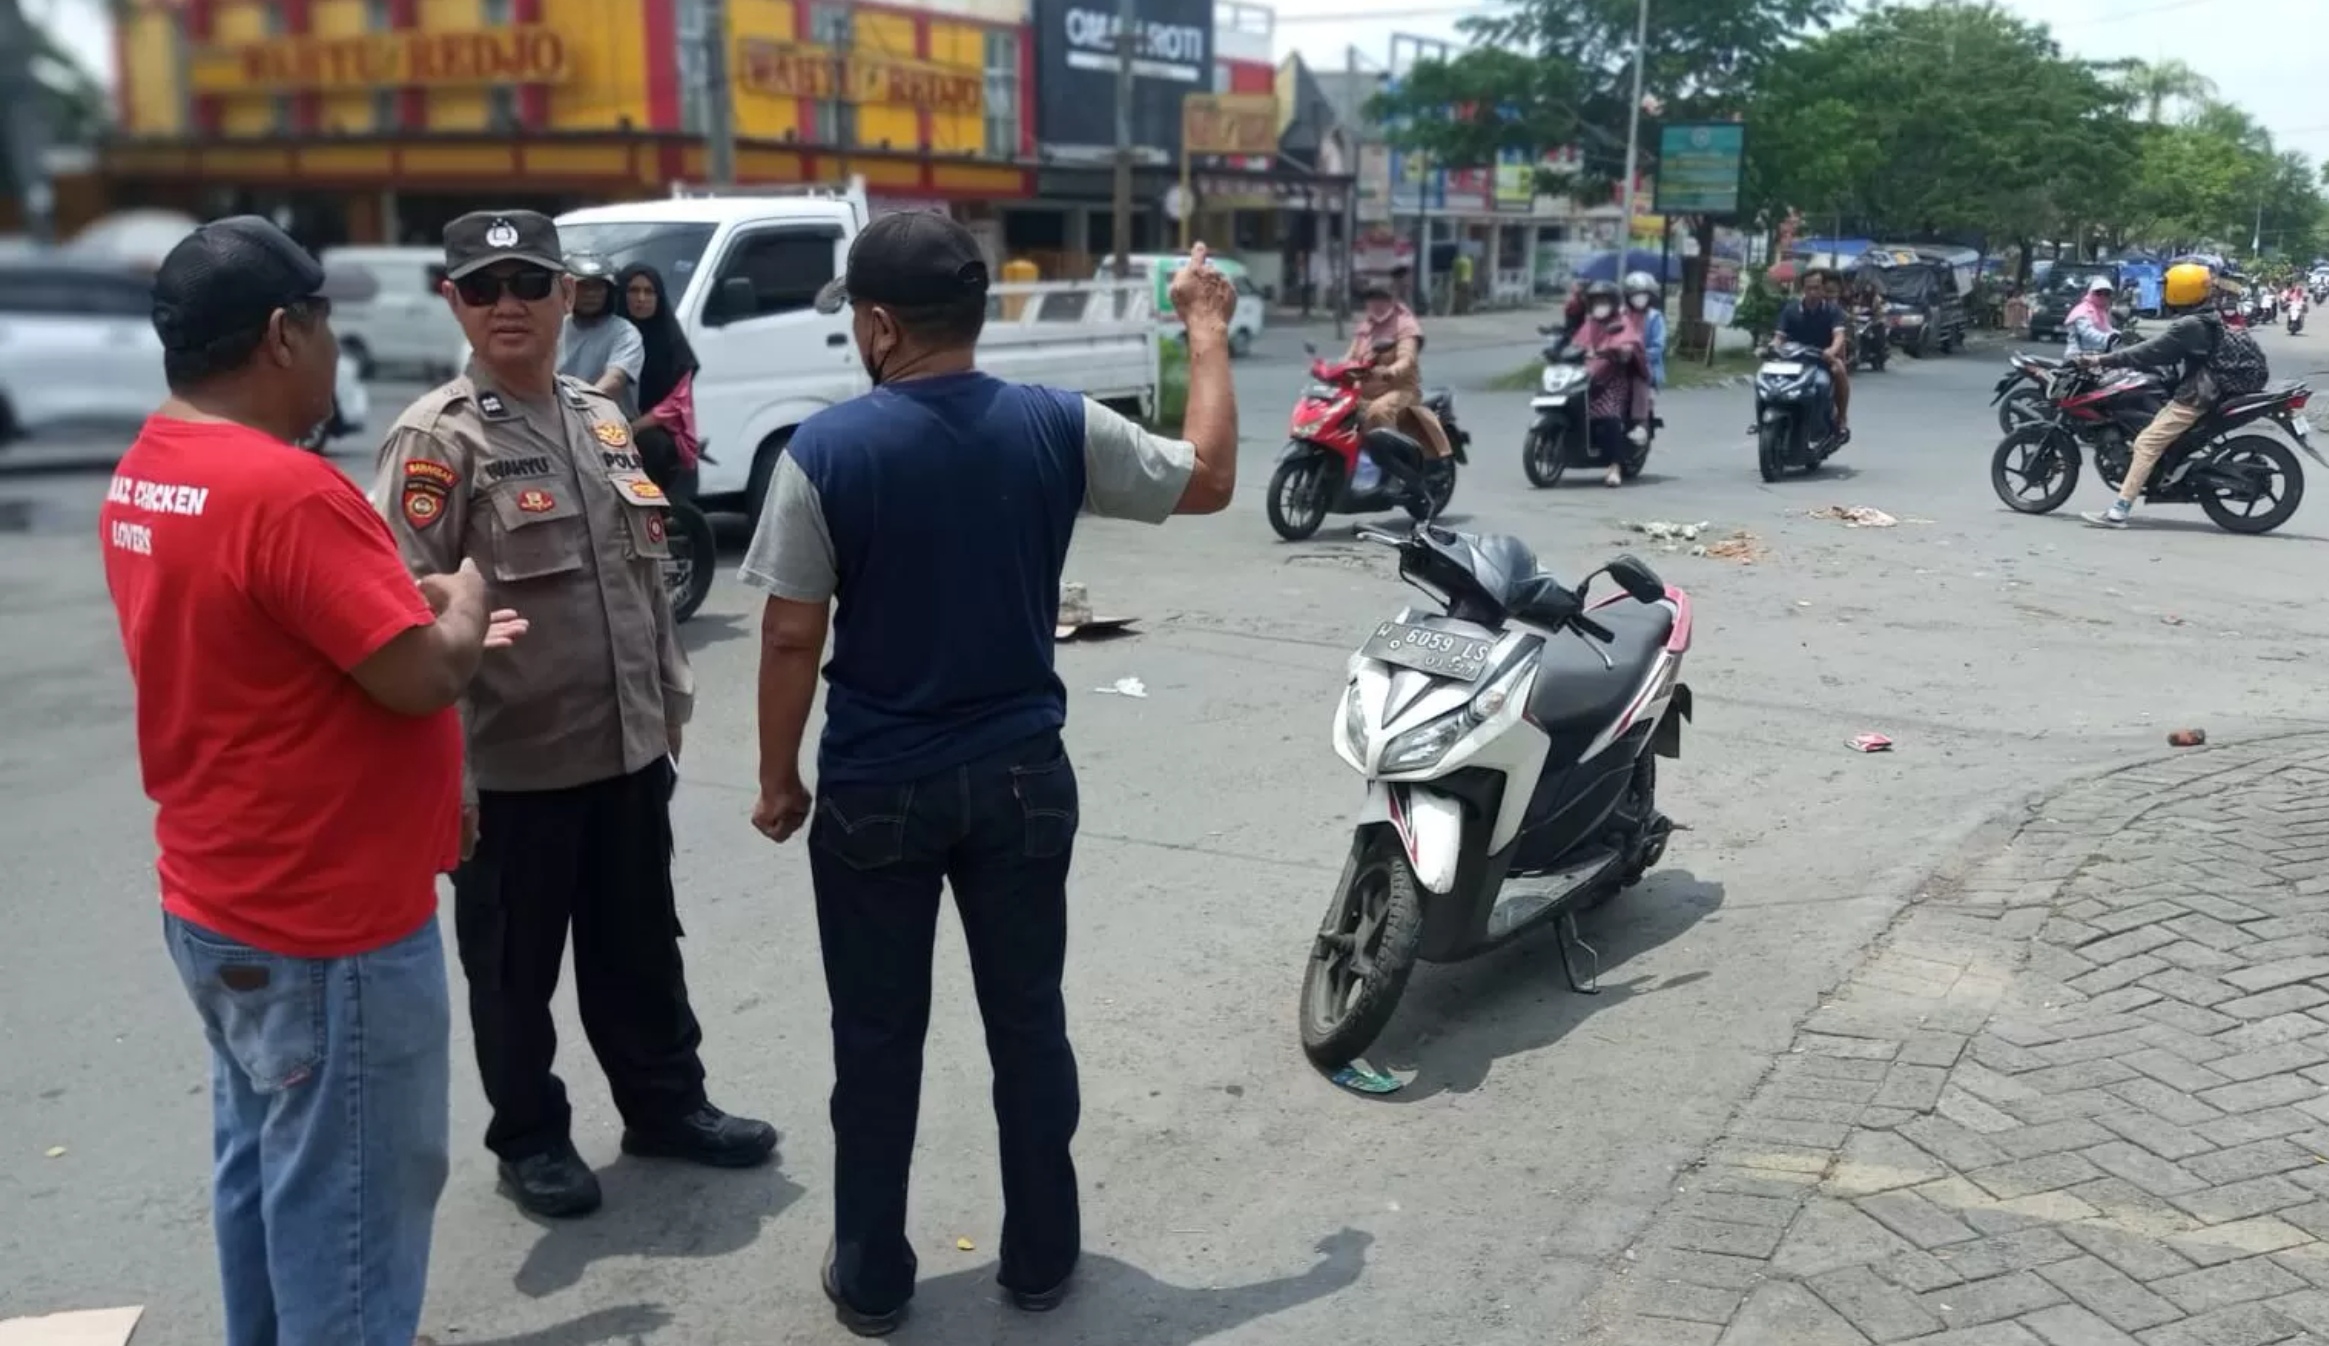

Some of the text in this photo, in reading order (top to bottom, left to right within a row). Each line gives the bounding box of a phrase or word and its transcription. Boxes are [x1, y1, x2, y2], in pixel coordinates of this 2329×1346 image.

[1147, 21, 1203, 62] ROTI
[134, 479, 209, 516] CHICKEN
[112, 520, 153, 556] LOVERS
[1405, 629, 1455, 652] 6059
[1461, 643, 1488, 661] LS
